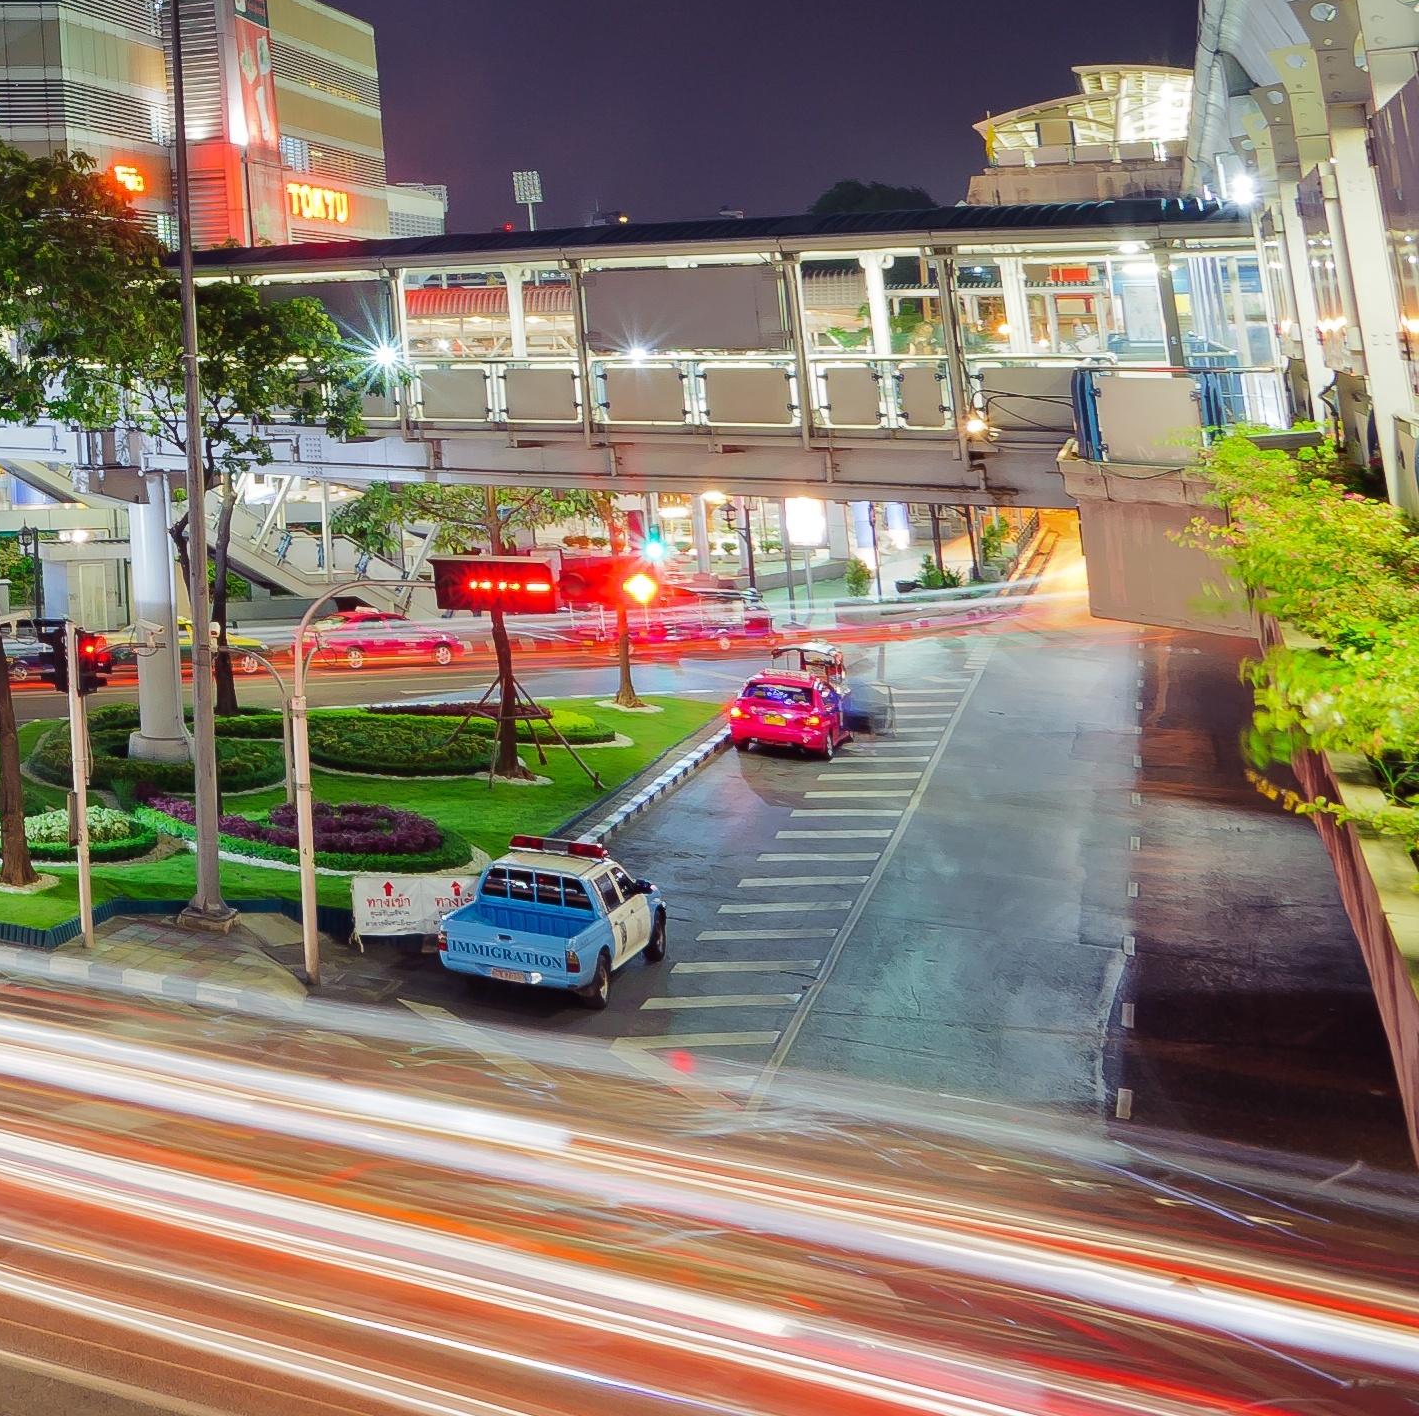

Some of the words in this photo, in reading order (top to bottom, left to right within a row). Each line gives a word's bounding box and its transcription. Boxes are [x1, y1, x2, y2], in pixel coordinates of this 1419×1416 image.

[287, 183, 349, 223] TOKYU
[366, 893, 411, 908] ทางเข้า
[451, 939, 563, 968] IMMIGRATION
